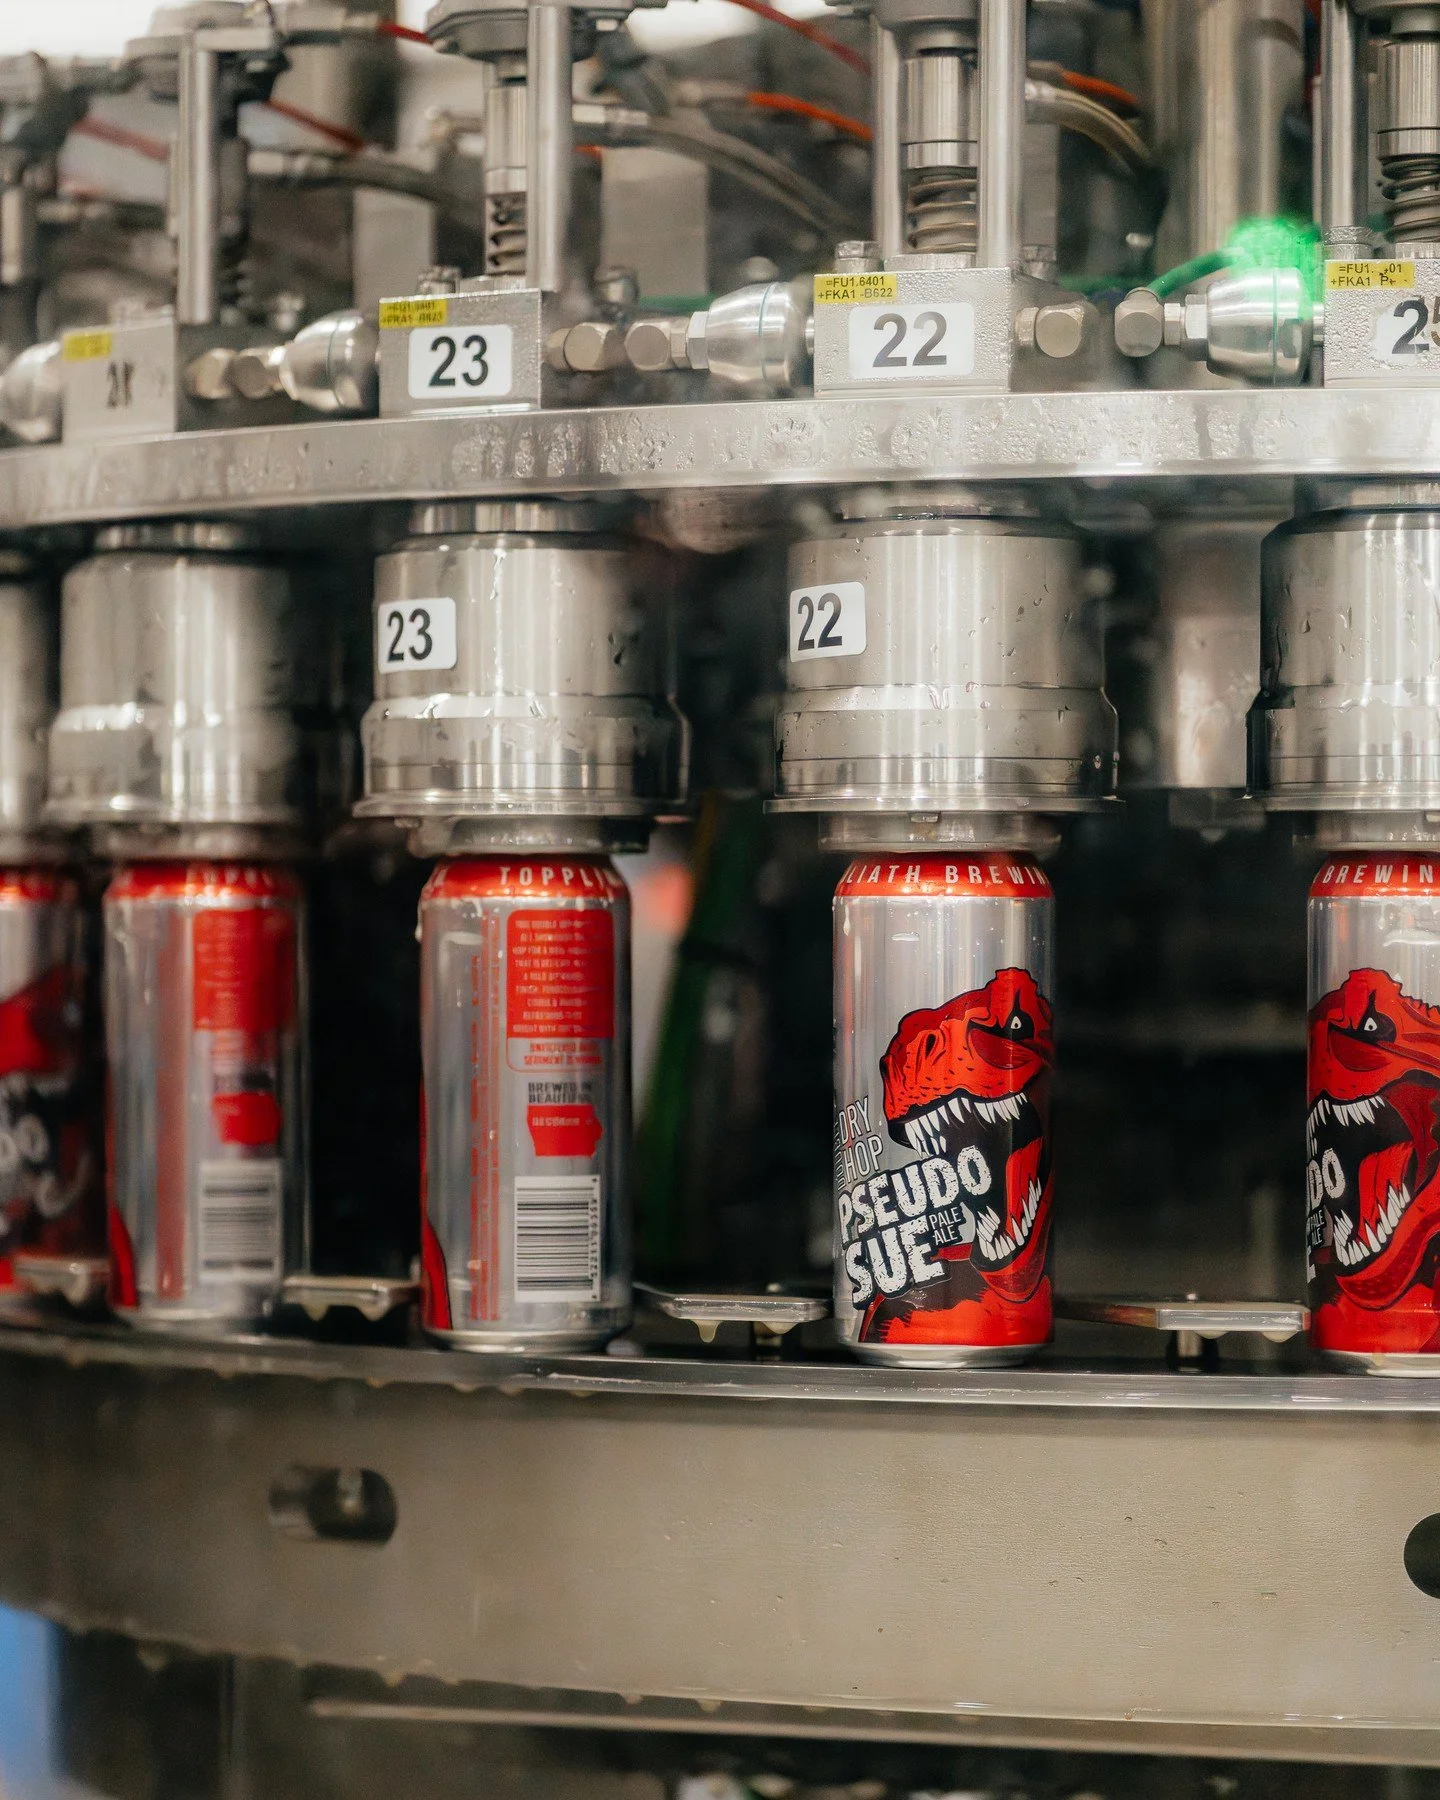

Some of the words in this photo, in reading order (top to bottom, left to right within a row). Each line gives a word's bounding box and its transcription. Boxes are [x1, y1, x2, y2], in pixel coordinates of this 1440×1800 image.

[818, 289, 856, 300] +FKA1
[860, 288, 893, 299] -B622
[873, 311, 947, 367] 22
[1391, 295, 1440, 355] 2
[429, 335, 488, 387] 23
[387, 608, 433, 662] 23
[798, 592, 842, 651] 22
[841, 865, 921, 884] LIATH
[945, 865, 1050, 884] BREWIN
[839, 1096, 871, 1146] DRY
[843, 1134, 884, 1183] HOP
[838, 1145, 992, 1244] PSEUDO
[928, 1206, 962, 1230] PALE
[845, 1215, 946, 1304] SUE
[933, 1225, 956, 1246] ALE
